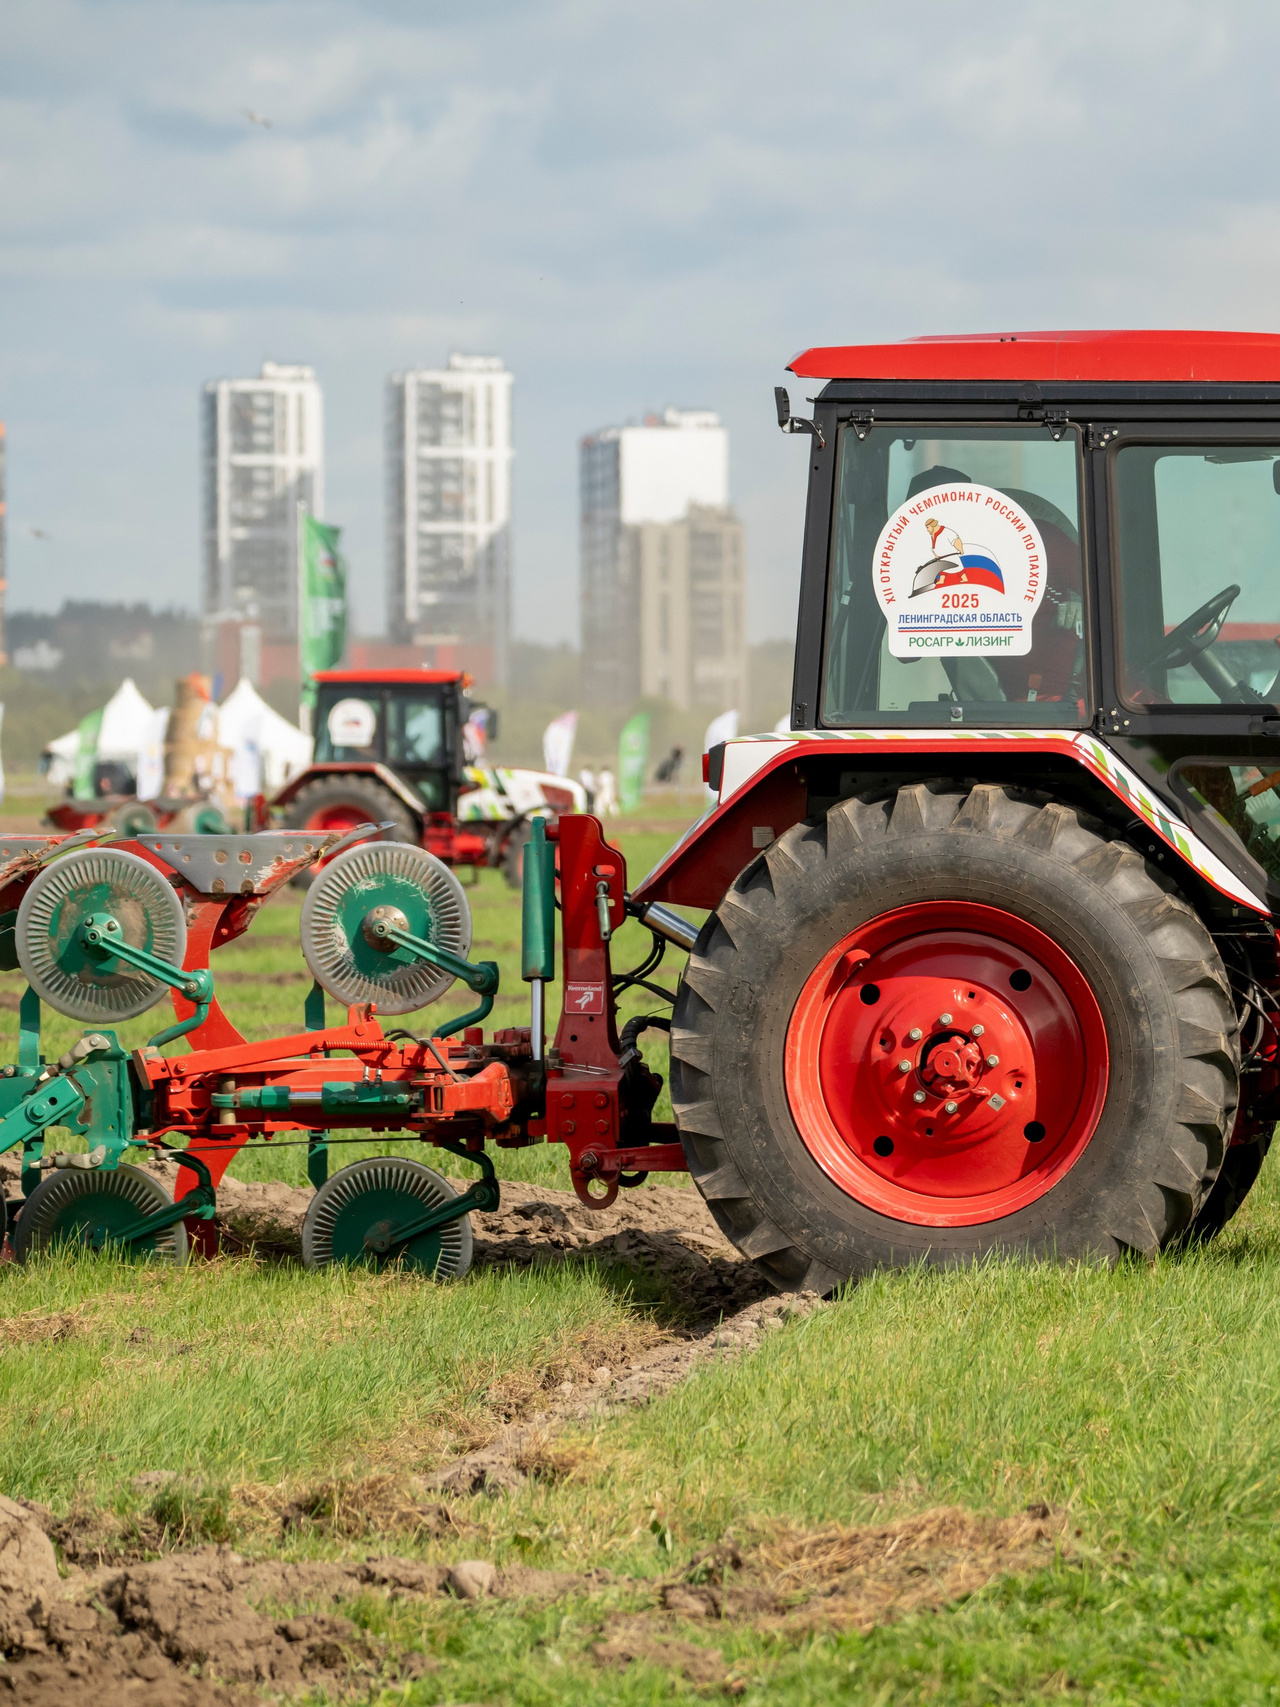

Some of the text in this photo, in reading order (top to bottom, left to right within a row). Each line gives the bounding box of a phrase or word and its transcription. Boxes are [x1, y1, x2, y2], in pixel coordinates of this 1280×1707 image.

[909, 491, 982, 516] ЧЕМПИОНАТ
[985, 497, 1027, 533] РОССИИ
[880, 515, 910, 584] ОТКРЫТЫЙ
[1022, 534, 1036, 551] ПО
[1023, 554, 1039, 603] ПАХОТЕ
[941, 593, 979, 608] 2025
[898, 612, 1023, 624] ЛЕНИНГРАДСКАЯ ОБЛАСТЬ
